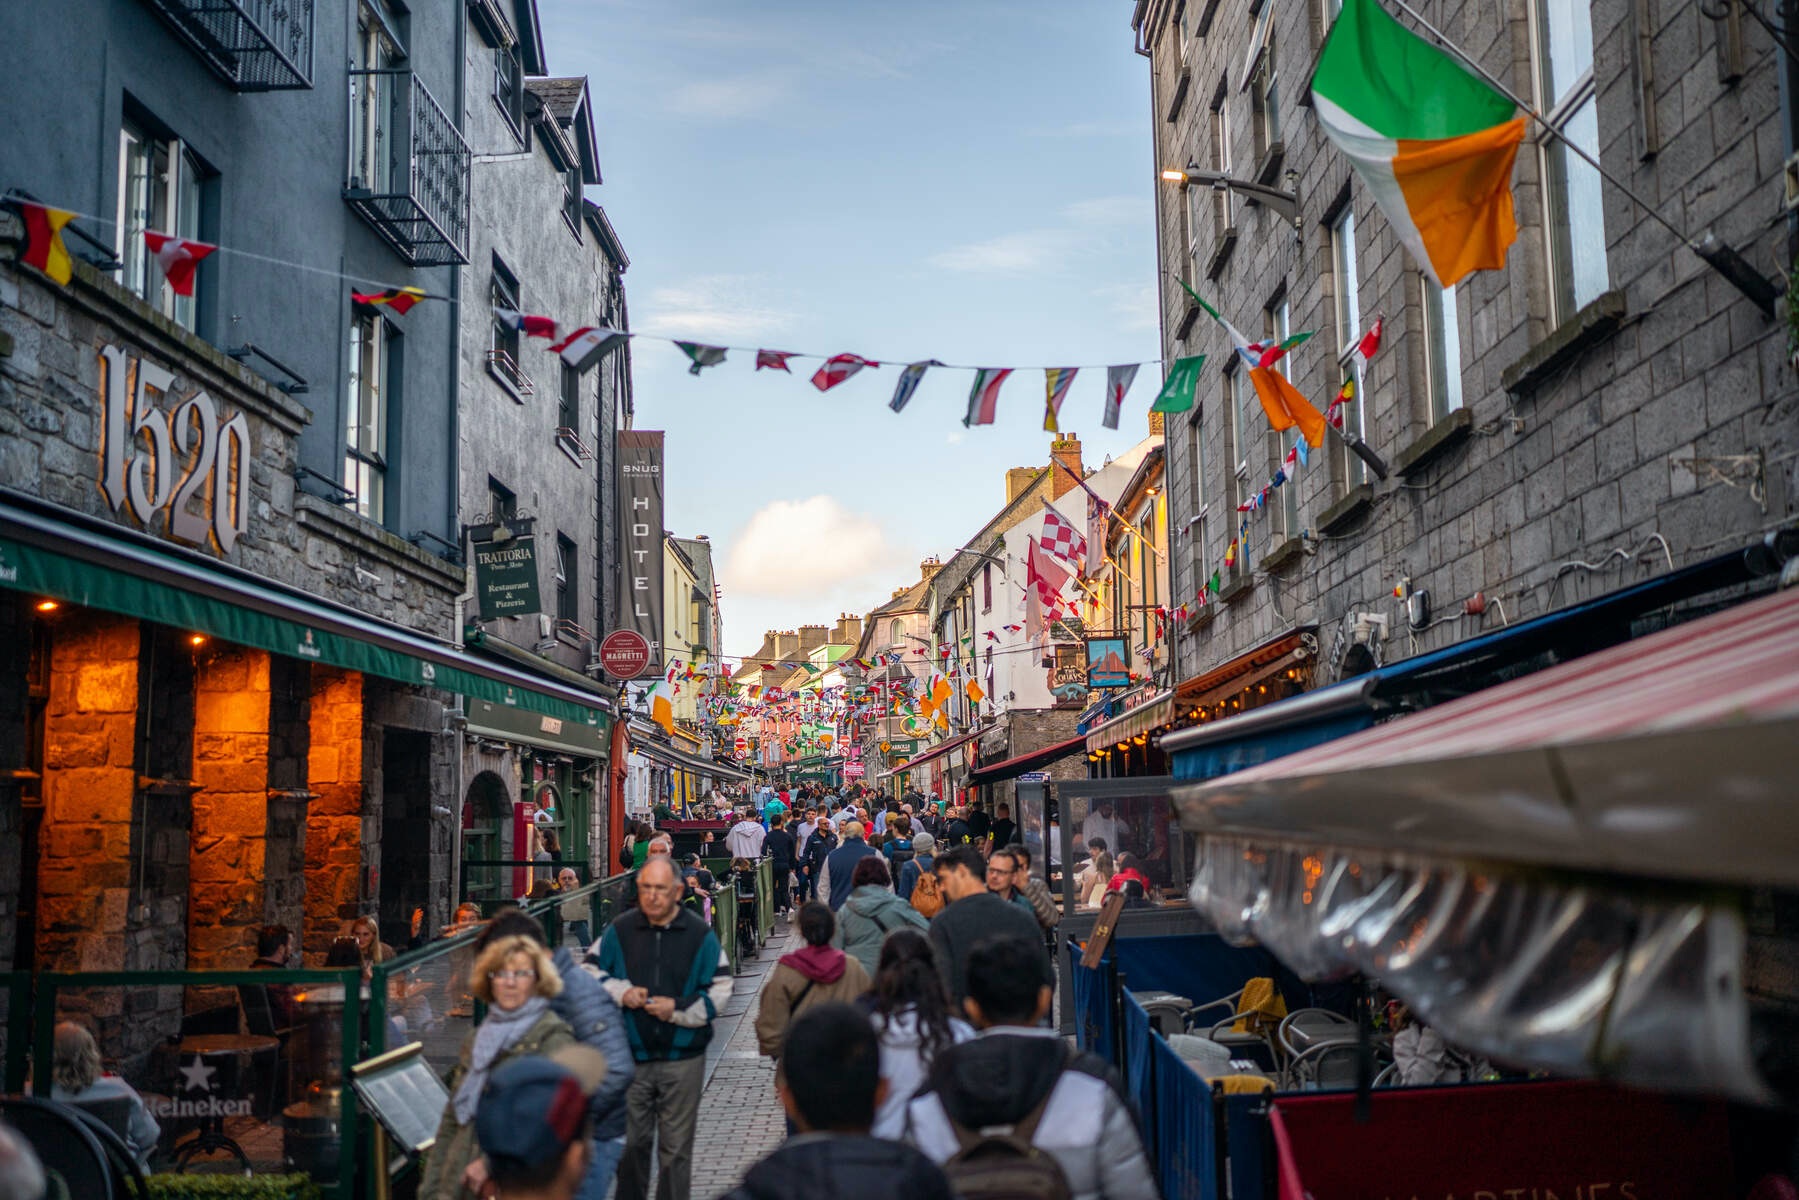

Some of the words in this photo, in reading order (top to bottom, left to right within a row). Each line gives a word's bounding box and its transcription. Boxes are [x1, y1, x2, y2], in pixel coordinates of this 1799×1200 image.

[98, 344, 250, 555] 1520
[623, 465, 660, 473] SNUG
[478, 548, 532, 565] TRATTORIA
[632, 496, 649, 617] HOTEL
[488, 582, 529, 592] Restaurant
[496, 599, 526, 608] Pizzeria
[1058, 674, 1083, 682] QUAYS
